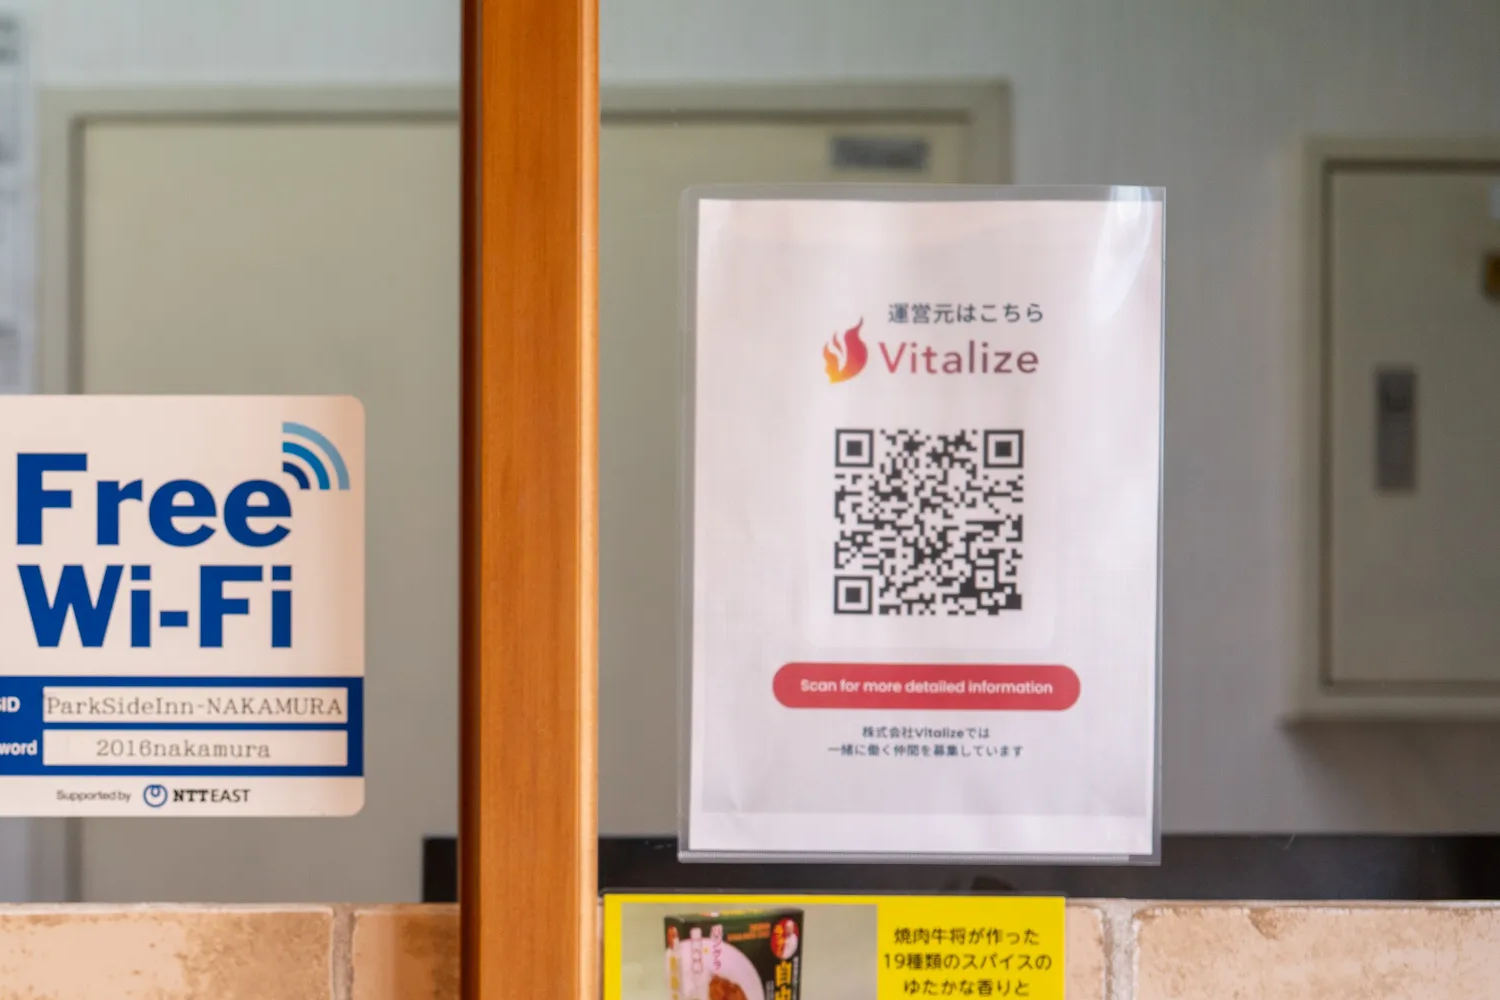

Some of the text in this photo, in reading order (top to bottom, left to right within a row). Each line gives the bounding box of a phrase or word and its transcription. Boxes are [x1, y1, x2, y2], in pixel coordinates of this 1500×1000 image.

[888, 303, 1044, 325] 運営元はこちら
[878, 340, 1039, 375] Vitalize
[17, 453, 292, 547] Free
[17, 565, 292, 648] Wi-Fi
[800, 679, 1054, 694] Scan for more detailed information
[46, 697, 343, 716] ParkSideInn-NAKAMURA
[861, 726, 991, 739] 株式会社Vitalizeでは
[96, 740, 271, 758] 2016nakamura
[828, 744, 1025, 758] 一緒に働く仲間を募集しています
[56, 789, 117, 802] Supported
[894, 927, 1040, 945] 焼肉牛将が作った
[884, 952, 1053, 971] 19種類のスパイスの
[903, 978, 1030, 997] ゆたかな香りと
